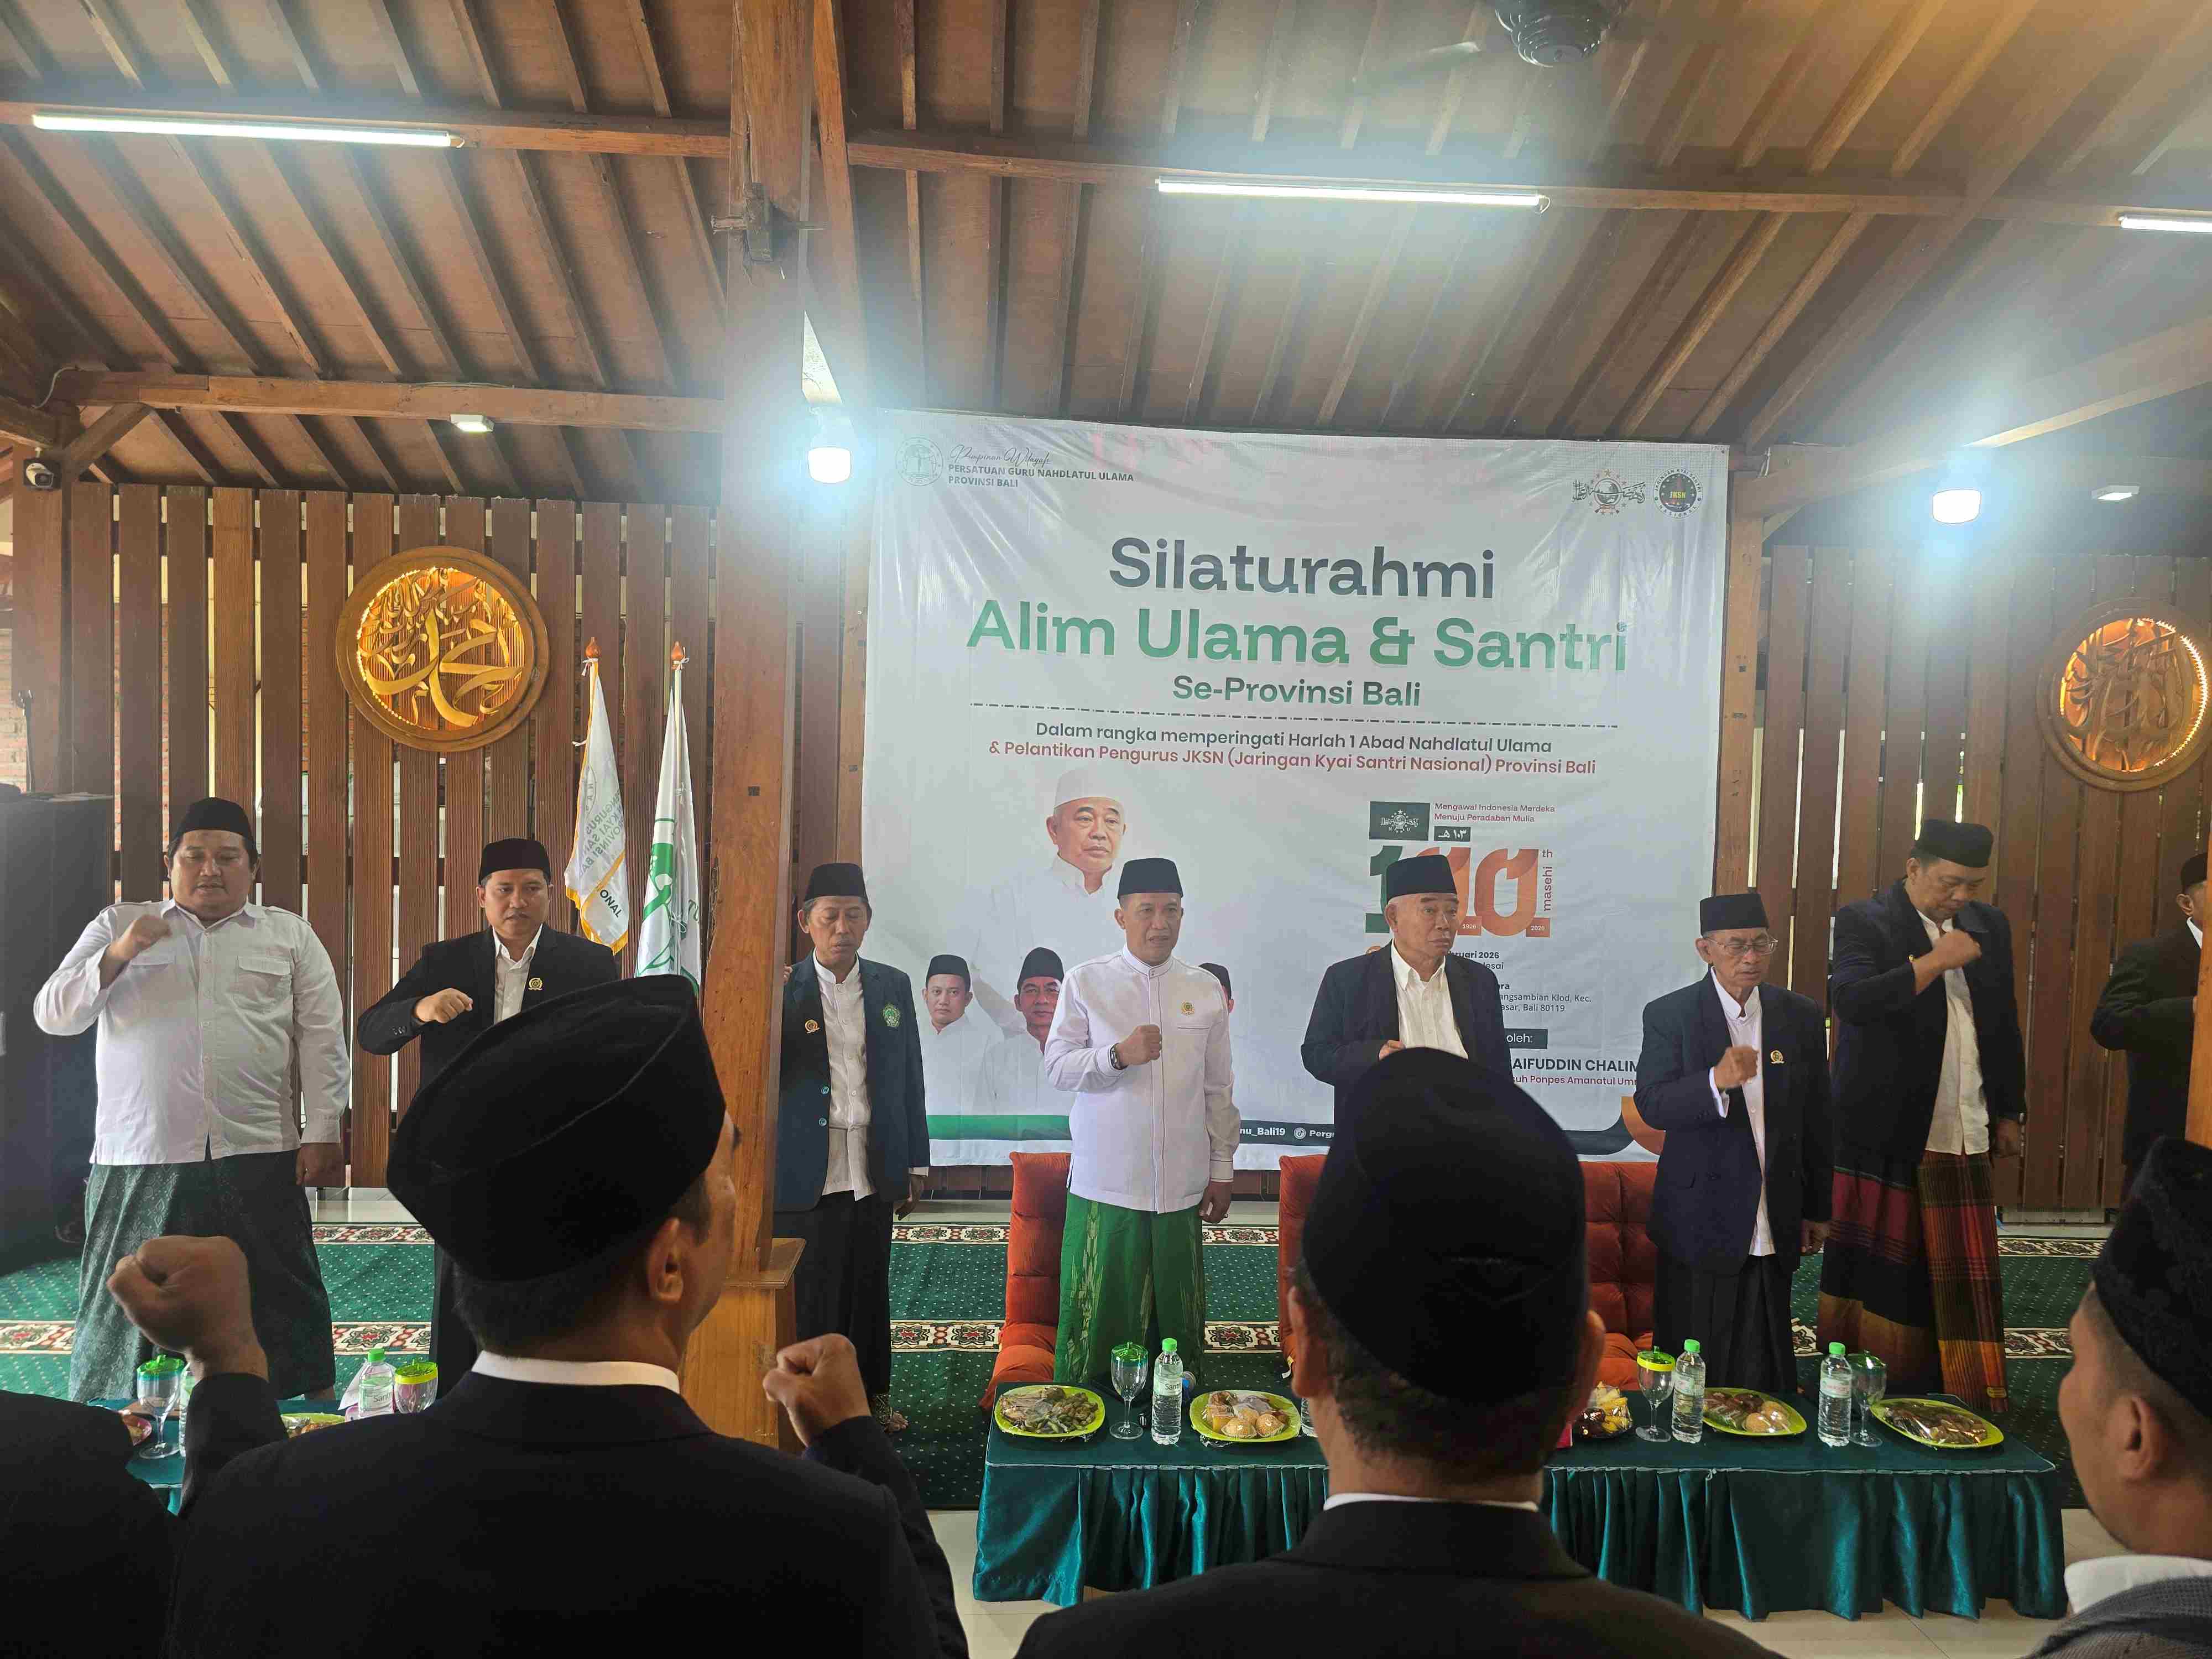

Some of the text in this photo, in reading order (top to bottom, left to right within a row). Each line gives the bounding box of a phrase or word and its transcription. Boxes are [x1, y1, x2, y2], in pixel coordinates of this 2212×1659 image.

[950, 444, 1000, 465] Pimpinan
[948, 464, 1134, 481] PERSATUAN GURU NAHDLATUL ULAMA
[948, 476, 1018, 487] PROVINSI BALI
[1109, 536, 1494, 598] Silaturahmi
[966, 599, 1628, 671] Alim Ulama & Santri
[1173, 675, 1421, 706] Se-Provinsi Bali
[1036, 722, 1552, 753] Dalam rangka memperingati Harlah 1 Abad Nahdlatul Ulama
[989, 740, 1596, 775] & Pelantikan Pengurus JKSN (Jaringan Kyai Santri Nasional) Provinsi Bali
[1434, 802, 1556, 813] Mengawal Indonesia Merdeka
[1434, 813, 1465, 822] Menuju
[1467, 813, 1511, 822] Peradaban
[1542, 866, 1553, 912] masehi
[600, 889, 622, 918] ONAL
[1551, 994, 1572, 1003] Klod,
[1522, 1004, 1538, 1012] Bali
[1540, 1004, 1566, 1013] 80119
[1506, 1033, 1533, 1044] oleh:
[1512, 1058, 1582, 1071] AIFUDDIN
[1530, 1075, 1566, 1086] Ponpes
[1568, 1076, 1615, 1085] Amanatul
